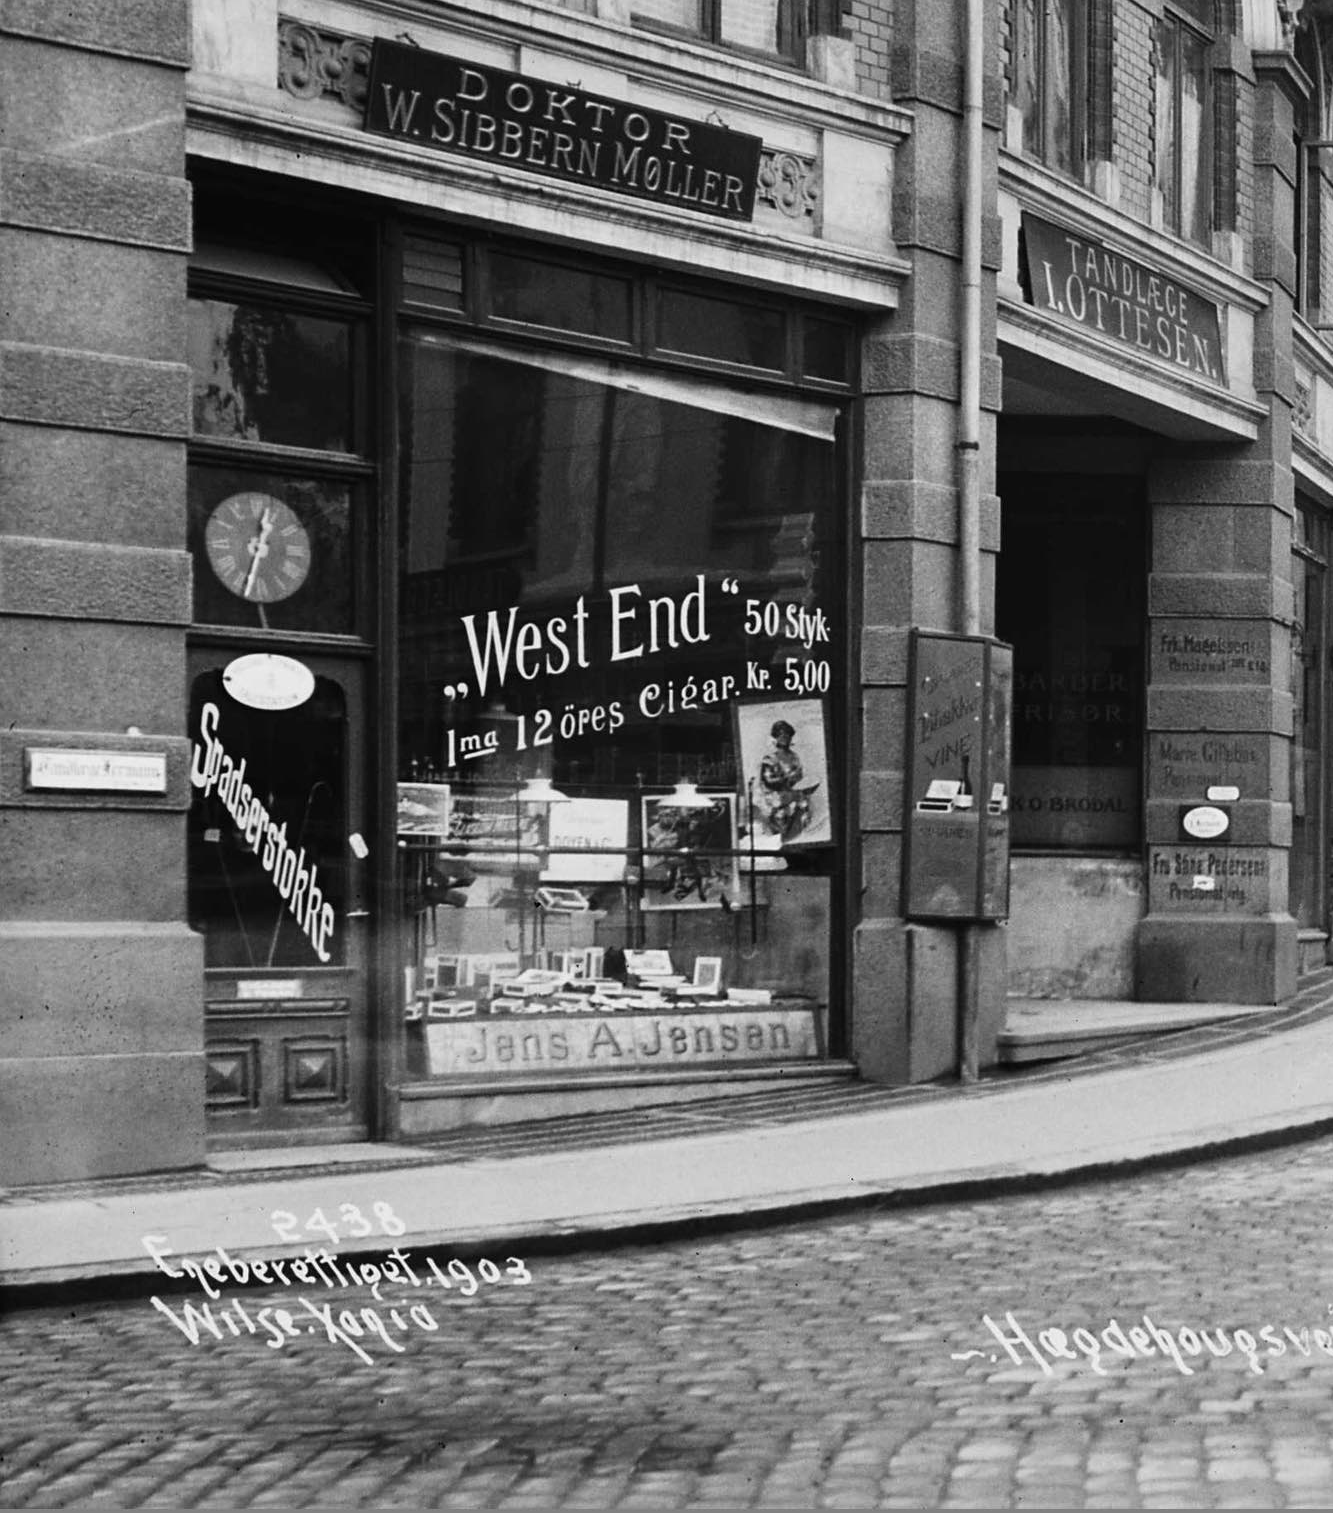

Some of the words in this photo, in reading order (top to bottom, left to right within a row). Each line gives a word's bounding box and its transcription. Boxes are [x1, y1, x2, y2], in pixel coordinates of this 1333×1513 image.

[381, 84, 421, 135] W.
[431, 98, 601, 178] SIBBERN
[610, 140, 745, 212] MØLLER
[457, 68, 692, 155] DOKTOR
[1065, 238, 1188, 325] TANDLÆGE
[744, 599, 780, 637] 50
[516, 709, 554, 751] 12
[560, 702, 625, 739] öres
[639, 676, 740, 718] Cigar.
[746, 661, 772, 690] Kr.
[784, 657, 831, 695] 5,00
[190, 702, 335, 963] Spadserstokke
[466, 1027, 568, 1065] Jens
